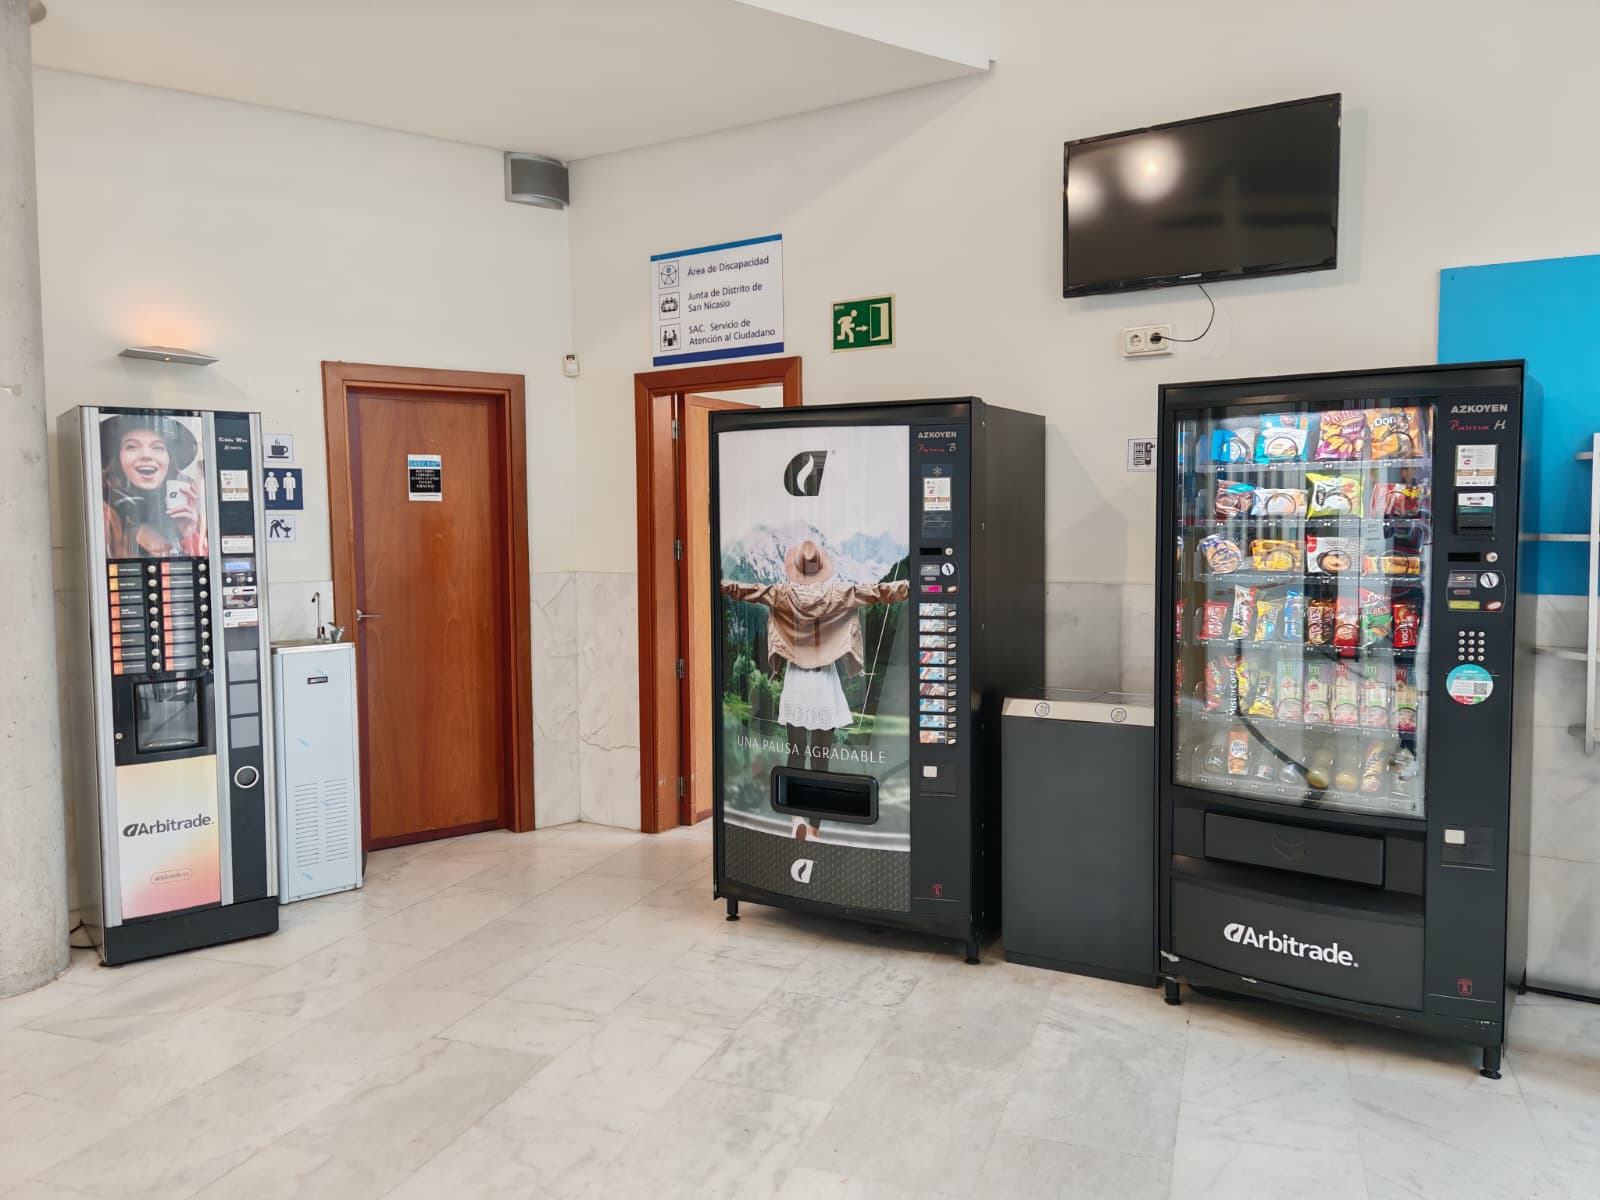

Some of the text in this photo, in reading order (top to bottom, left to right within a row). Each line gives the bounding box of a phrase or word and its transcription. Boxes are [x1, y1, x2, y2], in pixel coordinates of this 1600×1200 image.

[687, 255, 769, 277] Área de Discapacidad
[688, 282, 763, 301] Junta de Distrito de
[688, 299, 731, 312] San Nicasio
[688, 318, 751, 334] SAC. Servicio de
[689, 328, 776, 346] Atención al Ciudadano
[1451, 403, 1508, 414] AZKOYEN
[918, 431, 957, 439] AZKOYEN
[737, 735, 887, 763] UNA PAUSA AGRADABLE
